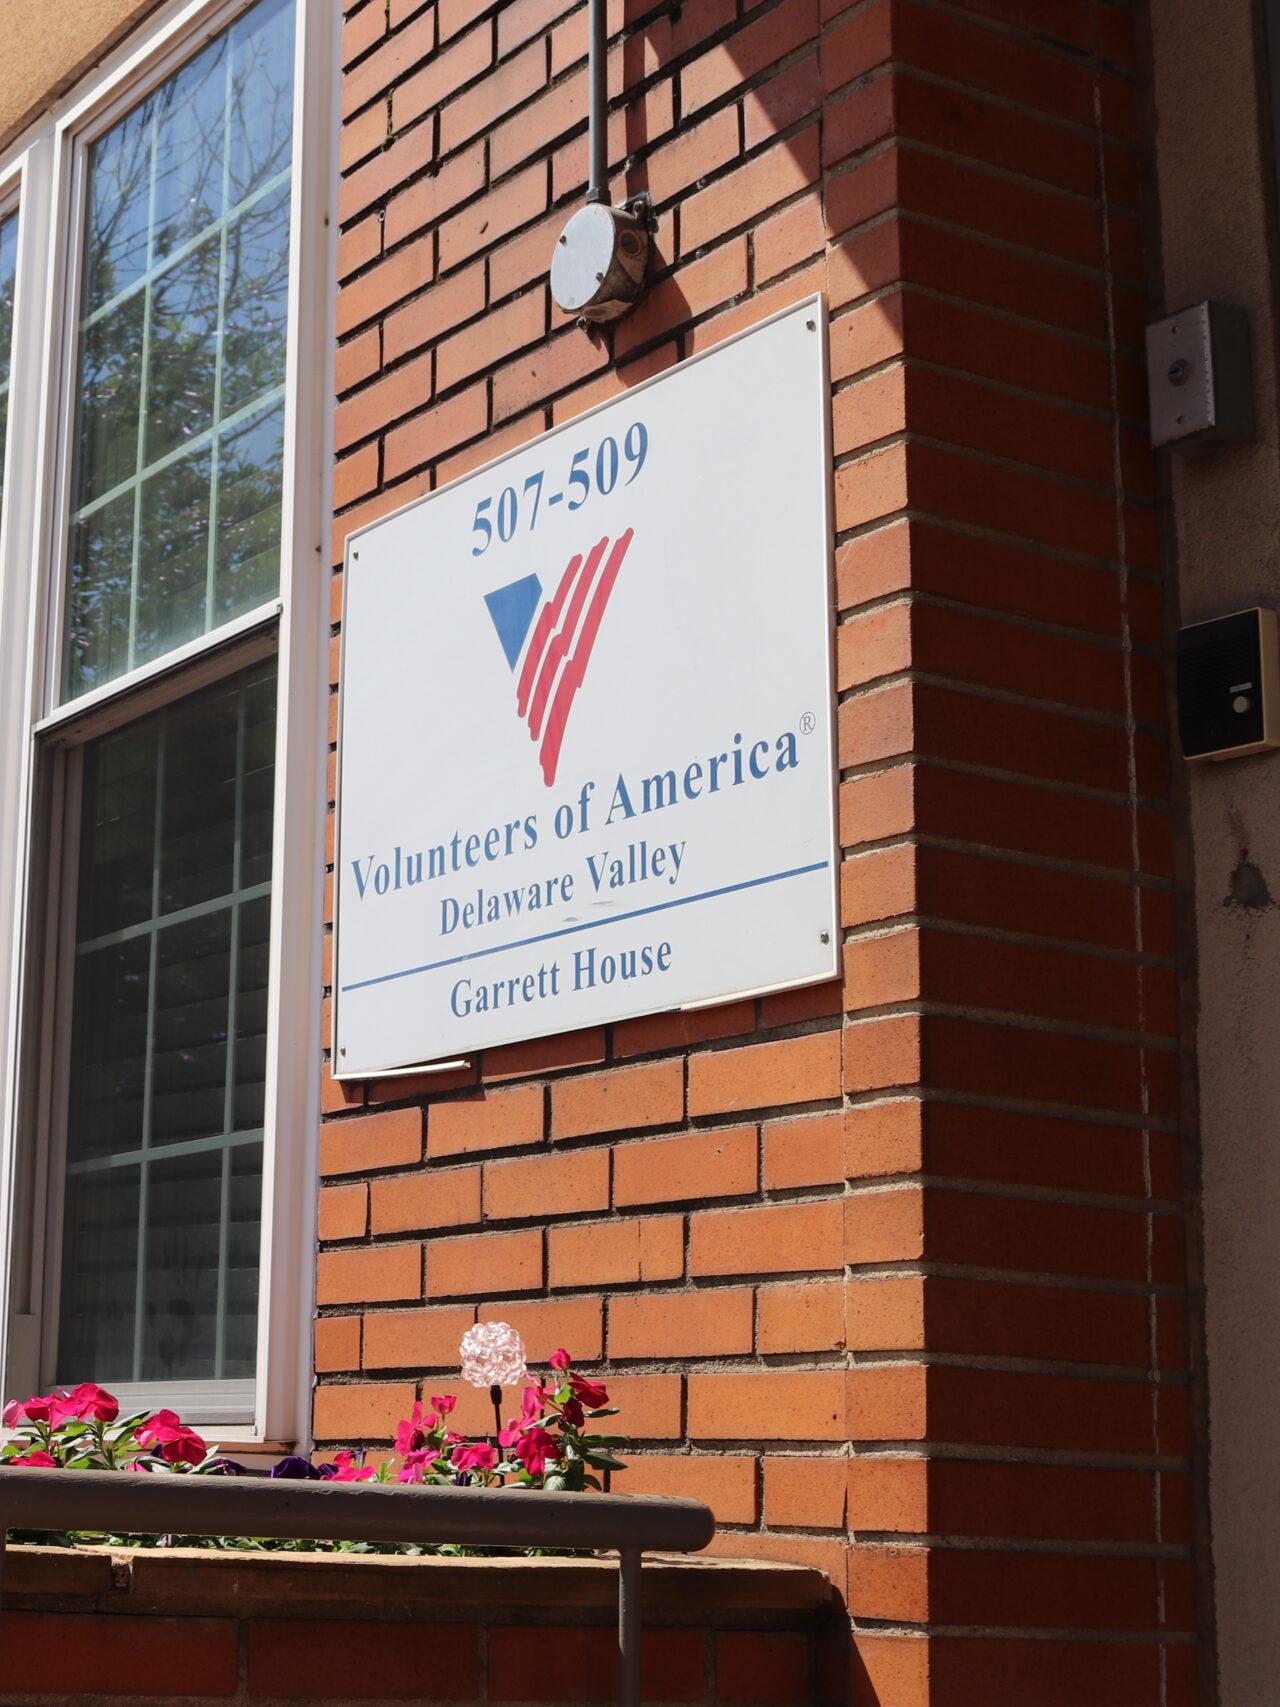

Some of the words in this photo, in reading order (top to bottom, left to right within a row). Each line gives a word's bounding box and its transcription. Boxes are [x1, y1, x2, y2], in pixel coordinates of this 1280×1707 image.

[471, 421, 649, 557] 507-509
[350, 812, 539, 902] Volunteers
[554, 781, 595, 840] of
[439, 873, 574, 937] Delaware
[586, 839, 688, 891] Valley
[449, 961, 561, 1019] Garrett
[572, 940, 673, 993] House
